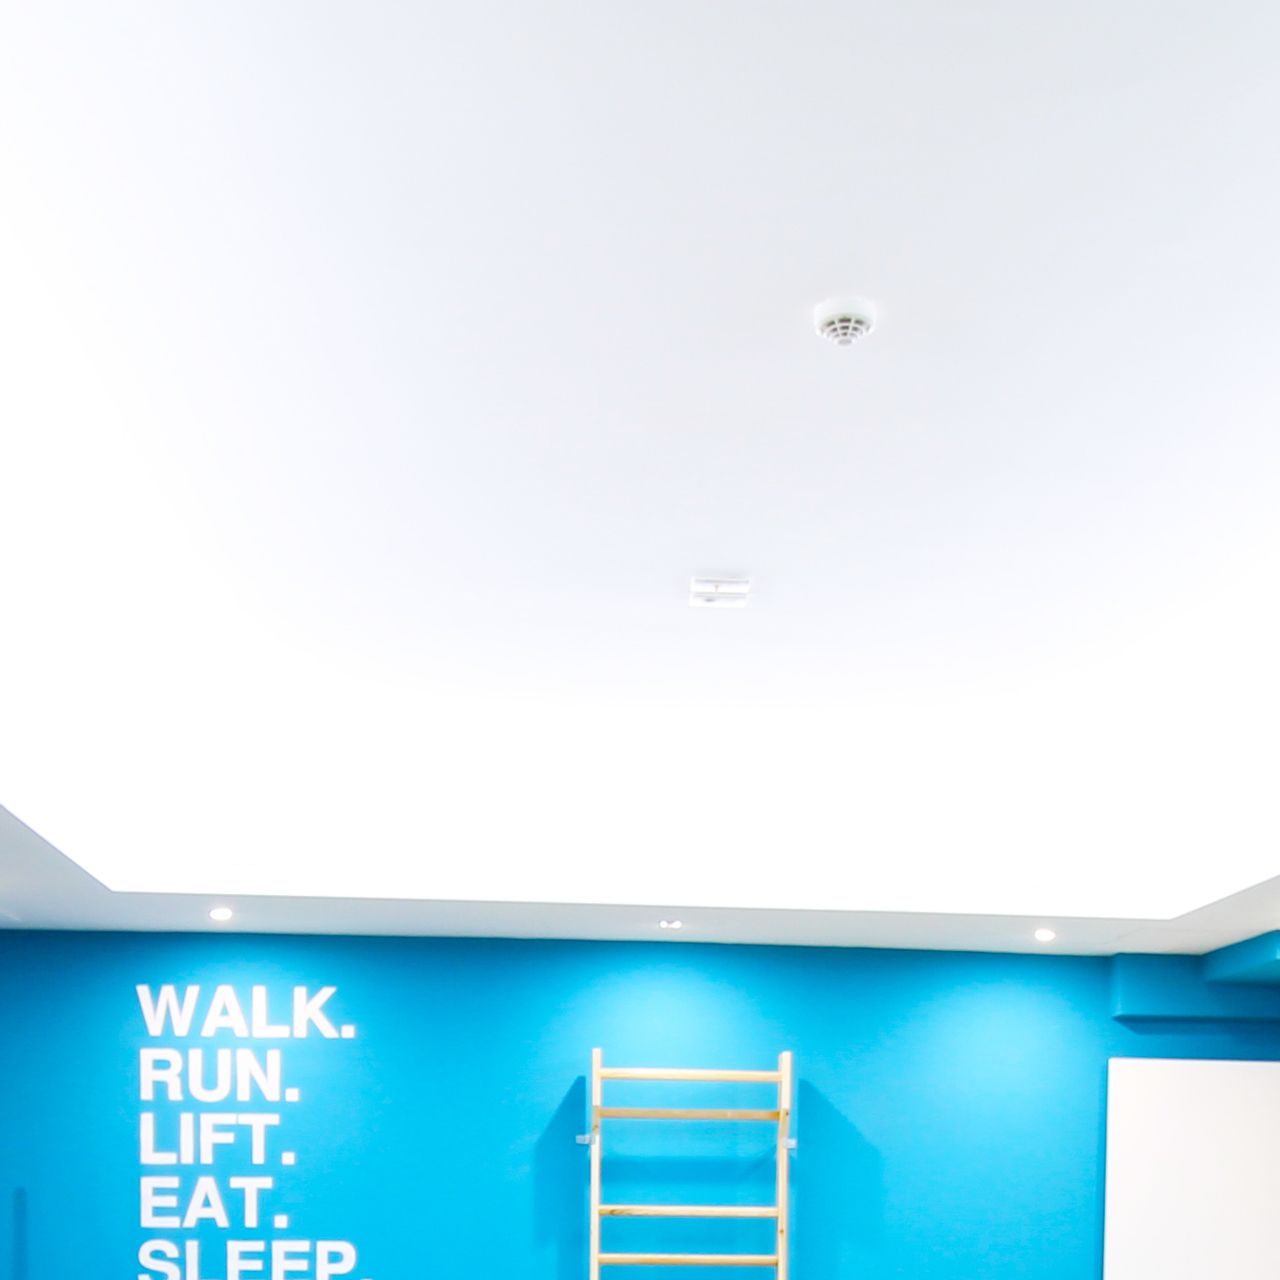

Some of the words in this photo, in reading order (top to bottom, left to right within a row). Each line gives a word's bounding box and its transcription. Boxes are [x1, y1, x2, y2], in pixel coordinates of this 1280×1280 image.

[135, 983, 357, 1040] WALK.
[138, 1046, 300, 1103] RUN.
[138, 1111, 297, 1167] LIFT.
[139, 1175, 289, 1229] EAT.
